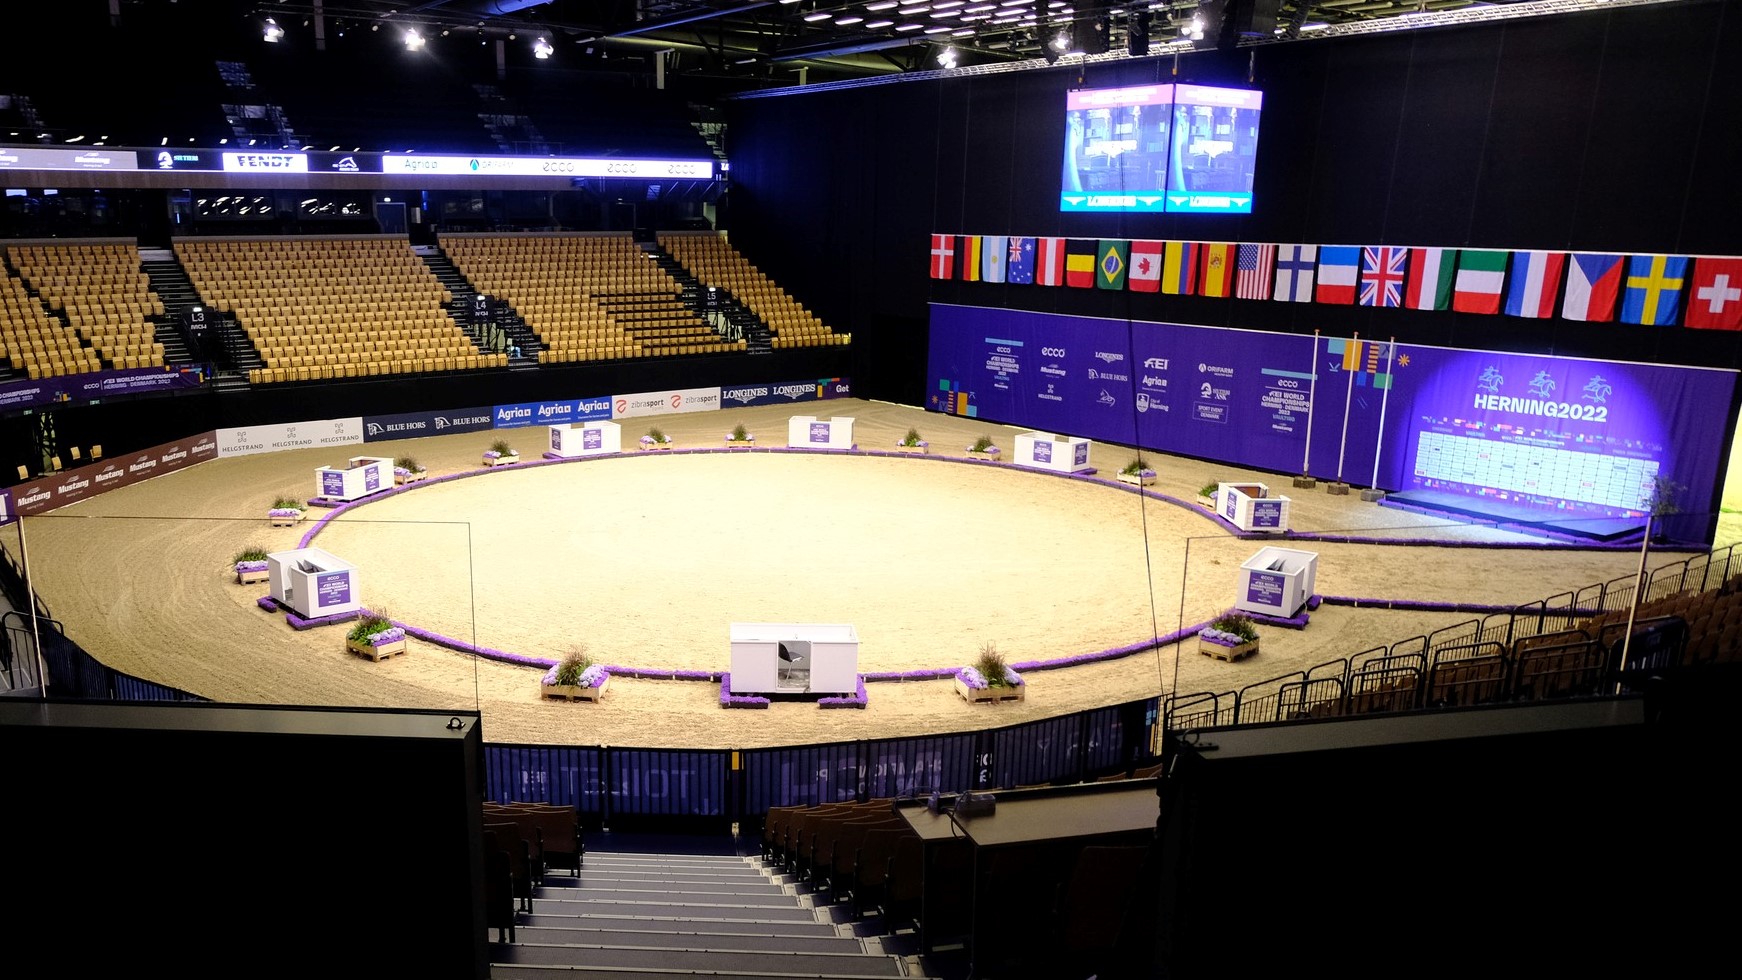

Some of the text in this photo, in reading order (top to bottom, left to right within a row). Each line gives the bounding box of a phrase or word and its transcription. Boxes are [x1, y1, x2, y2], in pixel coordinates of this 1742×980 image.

[236, 154, 293, 167] FENDT
[476, 302, 486, 310] L4
[191, 313, 205, 322] L3
[996, 346, 1011, 354] ecco
[1041, 347, 1065, 358] ecco
[1040, 366, 1066, 376] Mustang
[1207, 365, 1234, 374] ORIFARM
[1100, 372, 1113, 380] BLUE
[1142, 375, 1162, 386] Agria
[836, 384, 849, 393] Get
[1278, 379, 1298, 388] ecco
[723, 388, 768, 399] LONGINES
[773, 384, 815, 395] LONGINES
[685, 394, 717, 404] zibrasport
[1262, 395, 1309, 407] CHAMPIONSHIPS
[1284, 392, 1304, 400] WORLD
[578, 401, 603, 414] Agria
[631, 399, 664, 409] zibrasport
[1150, 403, 1169, 412] Herning
[1474, 393, 1608, 422] HERNING2022
[498, 407, 524, 420] Agria
[538, 404, 564, 416] Agria
[453, 418, 471, 426] BLUE
[473, 415, 490, 424] HORS
[387, 421, 426, 432] BLUE HORS
[272, 439, 312, 448] HELGSTRAND
[320, 435, 359, 444] HELGSTRAND
[192, 442, 215, 454] Mustang
[222, 444, 264, 452] HELGSTRAND
[162, 450, 187, 463] Mustang
[130, 459, 156, 473] Mustang
[95, 468, 124, 482] Mustang
[58, 479, 89, 494] Mustang
[18, 490, 51, 507] Mustang
